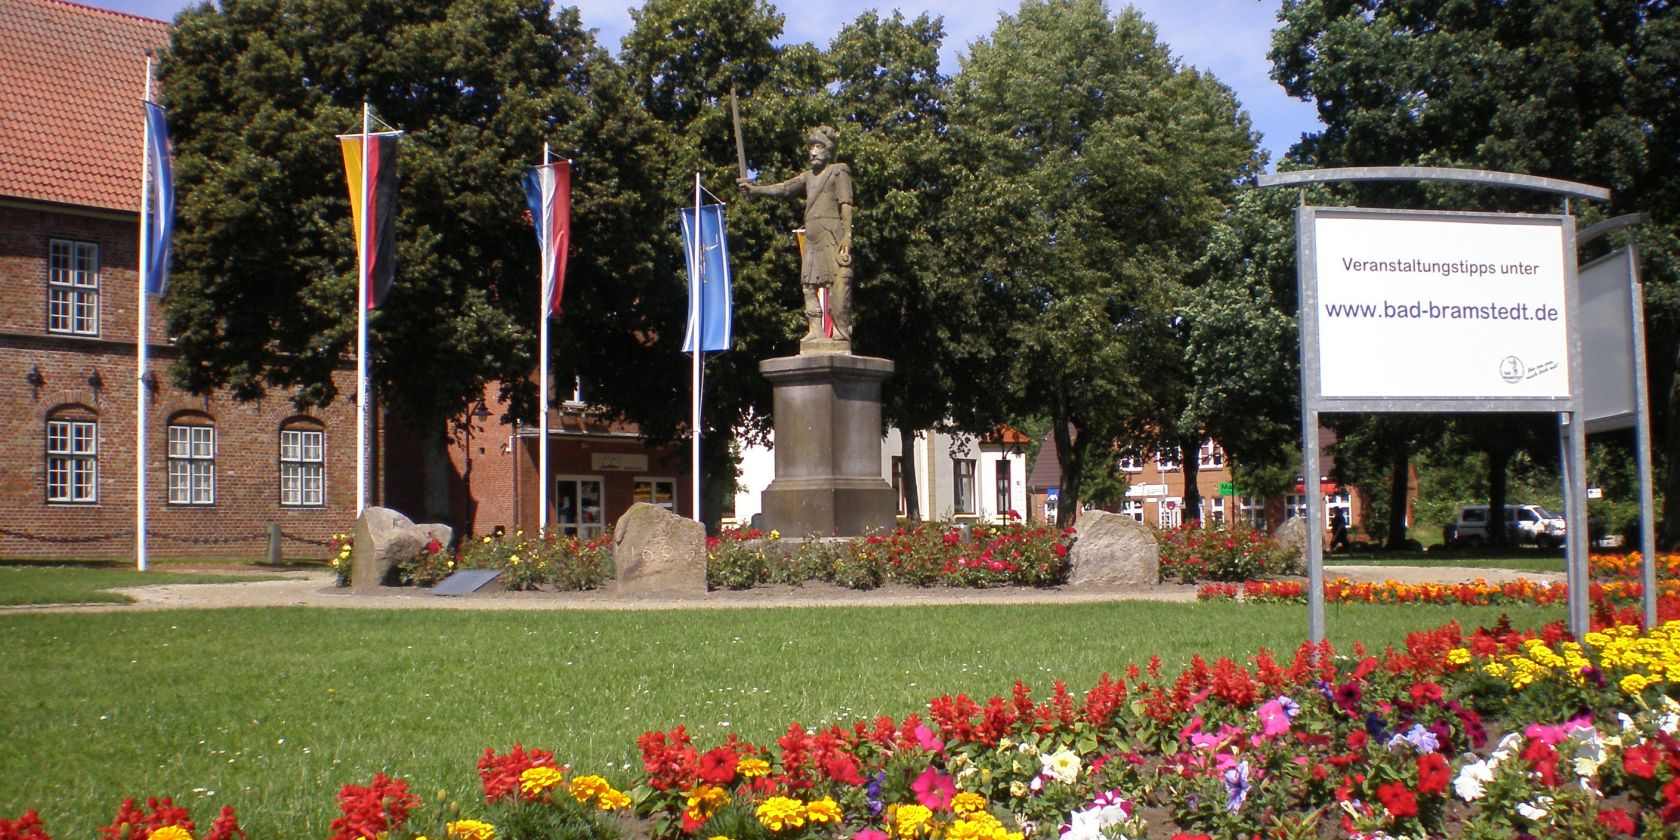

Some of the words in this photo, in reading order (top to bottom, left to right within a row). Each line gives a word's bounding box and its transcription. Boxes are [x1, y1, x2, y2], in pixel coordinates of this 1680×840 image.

[1342, 257, 1497, 277] Veranstaltungstipps
[1500, 262, 1540, 275] unter
[1325, 299, 1559, 321] www.bad-bramstedt.de
